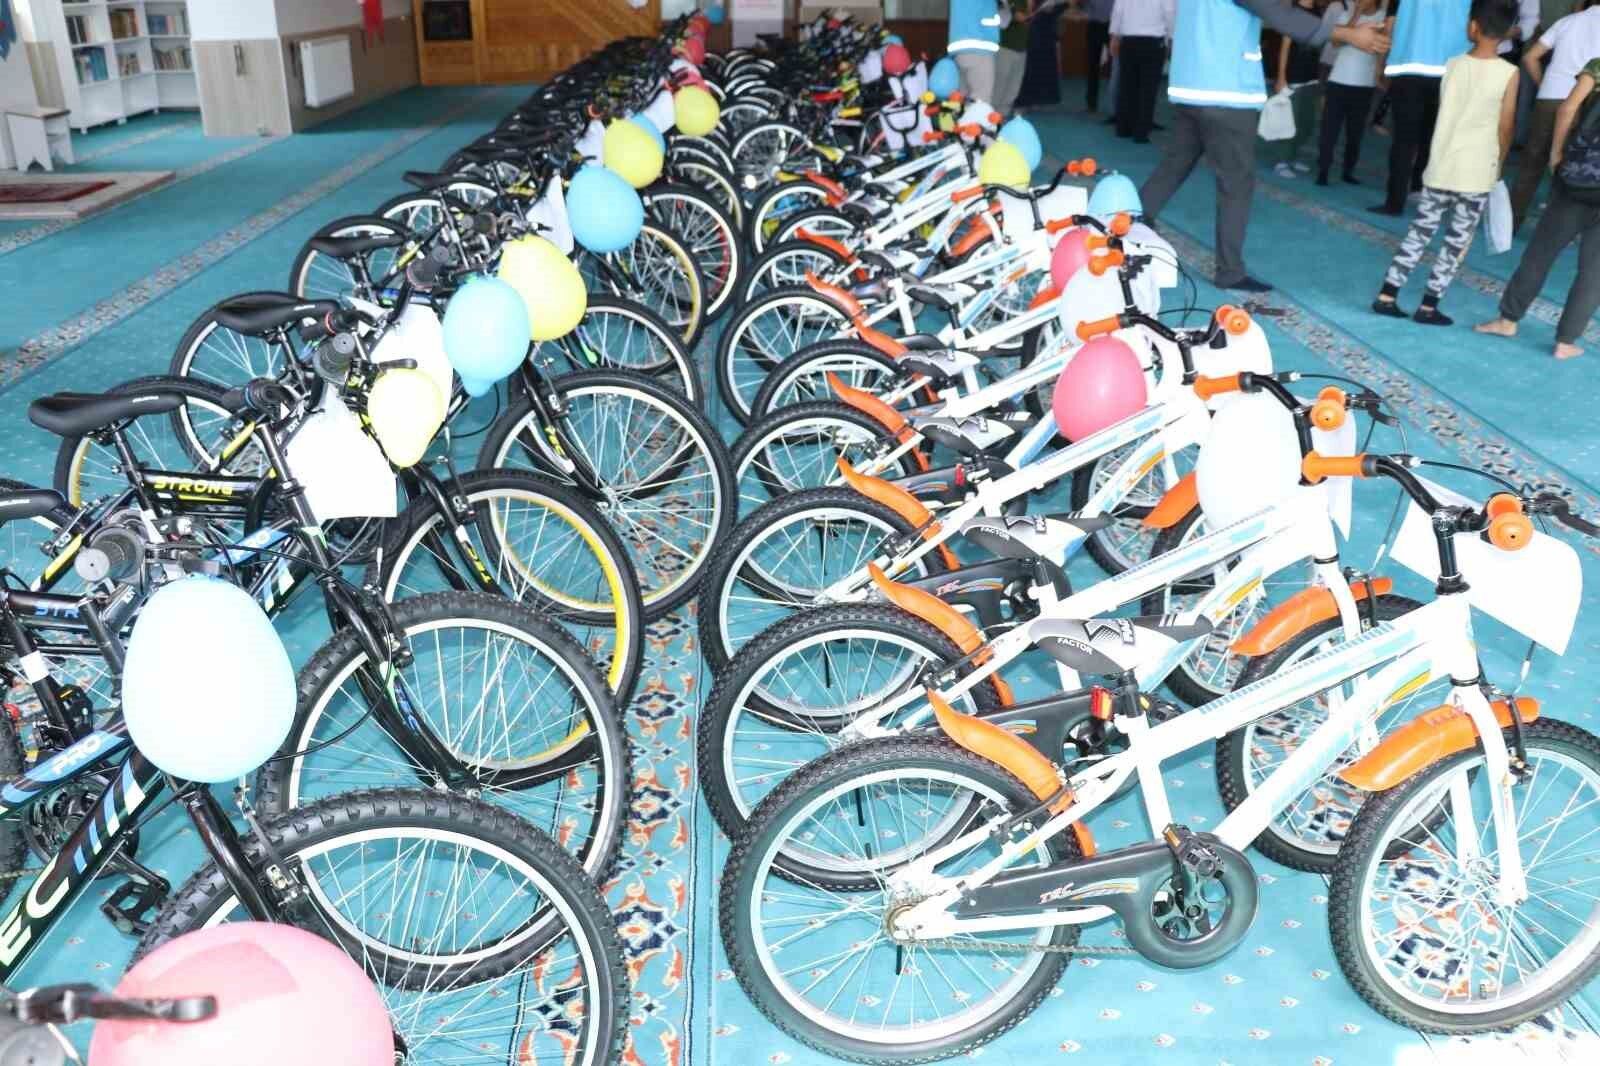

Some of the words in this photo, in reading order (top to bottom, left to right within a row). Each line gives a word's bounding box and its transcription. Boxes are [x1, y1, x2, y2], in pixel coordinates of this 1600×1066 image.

[154, 476, 233, 496] STRONG
[1057, 637, 1093, 655] FACTOR
[0, 851, 70, 967] EC
